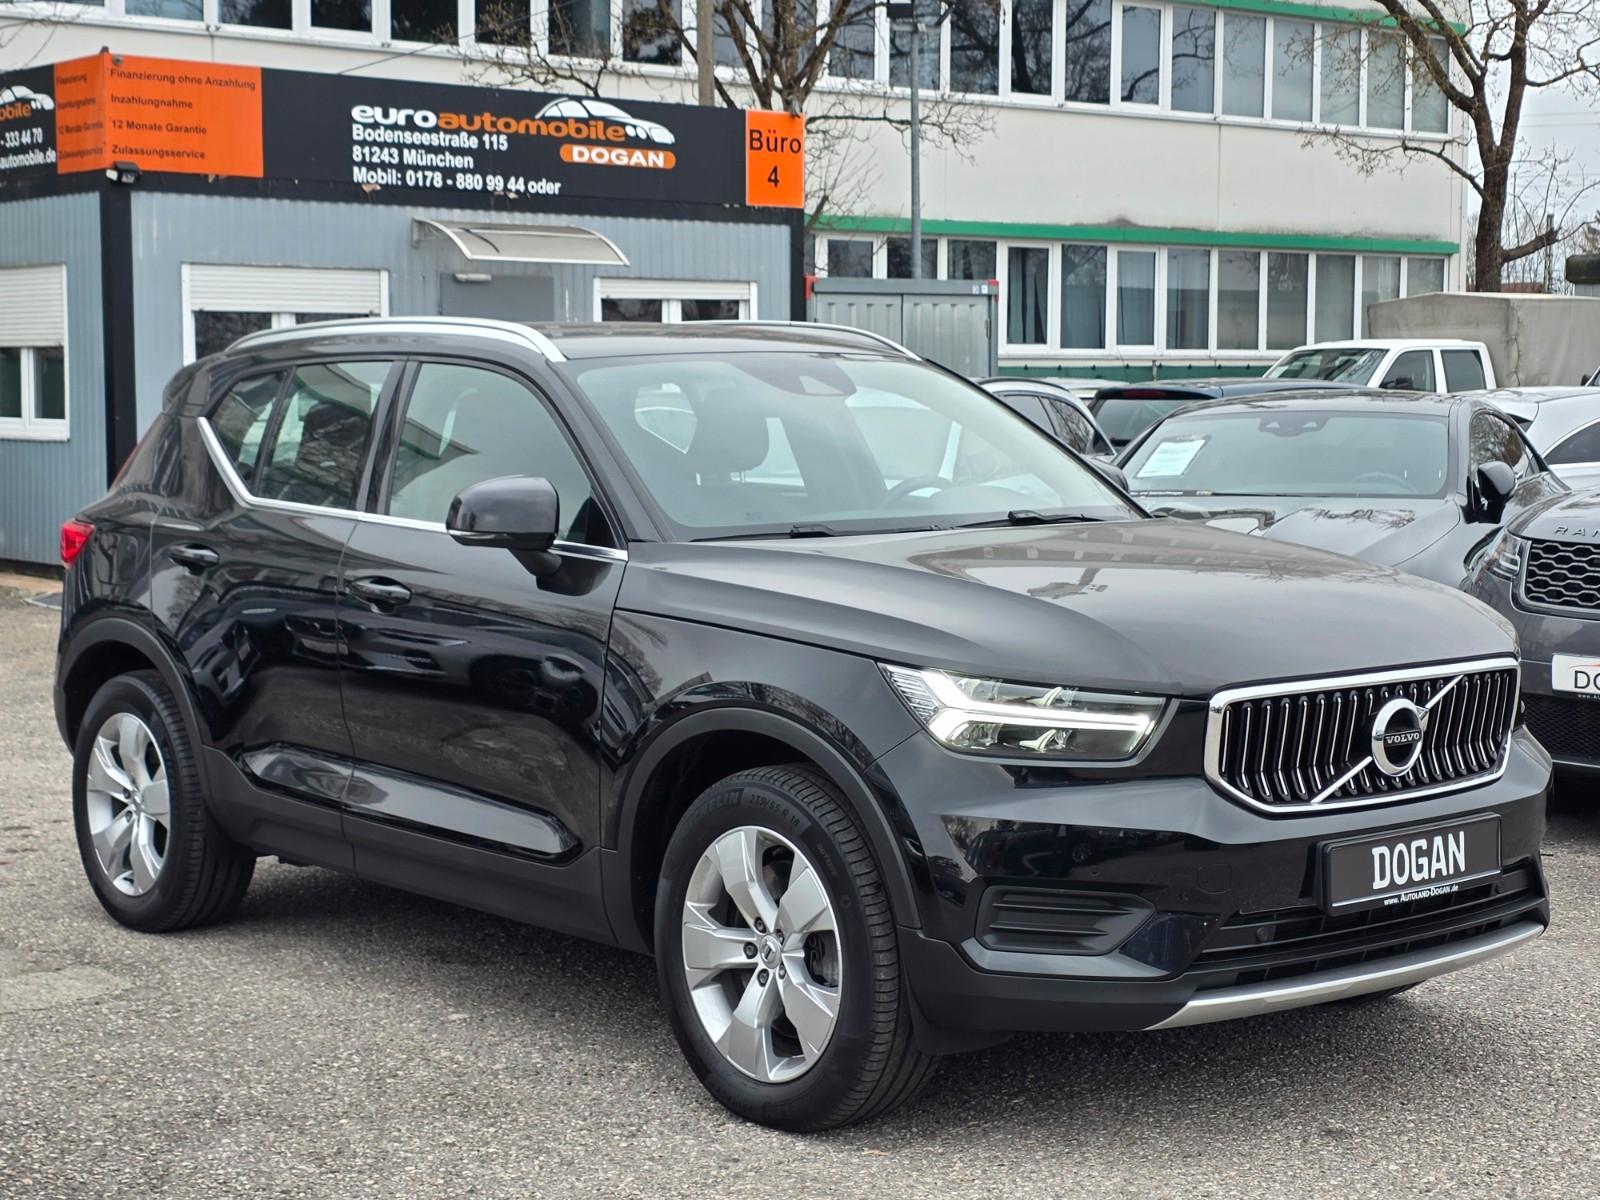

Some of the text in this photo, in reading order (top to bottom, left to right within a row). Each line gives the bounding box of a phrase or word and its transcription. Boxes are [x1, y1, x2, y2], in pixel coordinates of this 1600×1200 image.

[110, 68, 256, 91] Finanzierung ohne Anzahlung
[111, 94, 193, 109] Inzahlungnahme
[5, 130, 20, 148] 333
[21, 128, 32, 145] 44
[32, 127, 43, 144] 70
[111, 120, 207, 135] 12 Monate Garantie
[352, 124, 509, 151] Bodenseestraße 115
[112, 144, 206, 160] Zulassungsservice
[750, 129, 802, 154] Büro
[352, 145, 474, 170] 81243 München
[572, 145, 665, 169] DOGAN
[353, 166, 402, 186] Mobil:
[406, 169, 443, 188] 0178
[456, 172, 483, 191] 880
[486, 173, 504, 192] 99
[507, 175, 525, 193] 44
[527, 177, 562, 196] oder
[767, 166, 780, 188] 4
[1385, 732, 1420, 744] VOLVO
[1371, 831, 1466, 889] DOGAN
